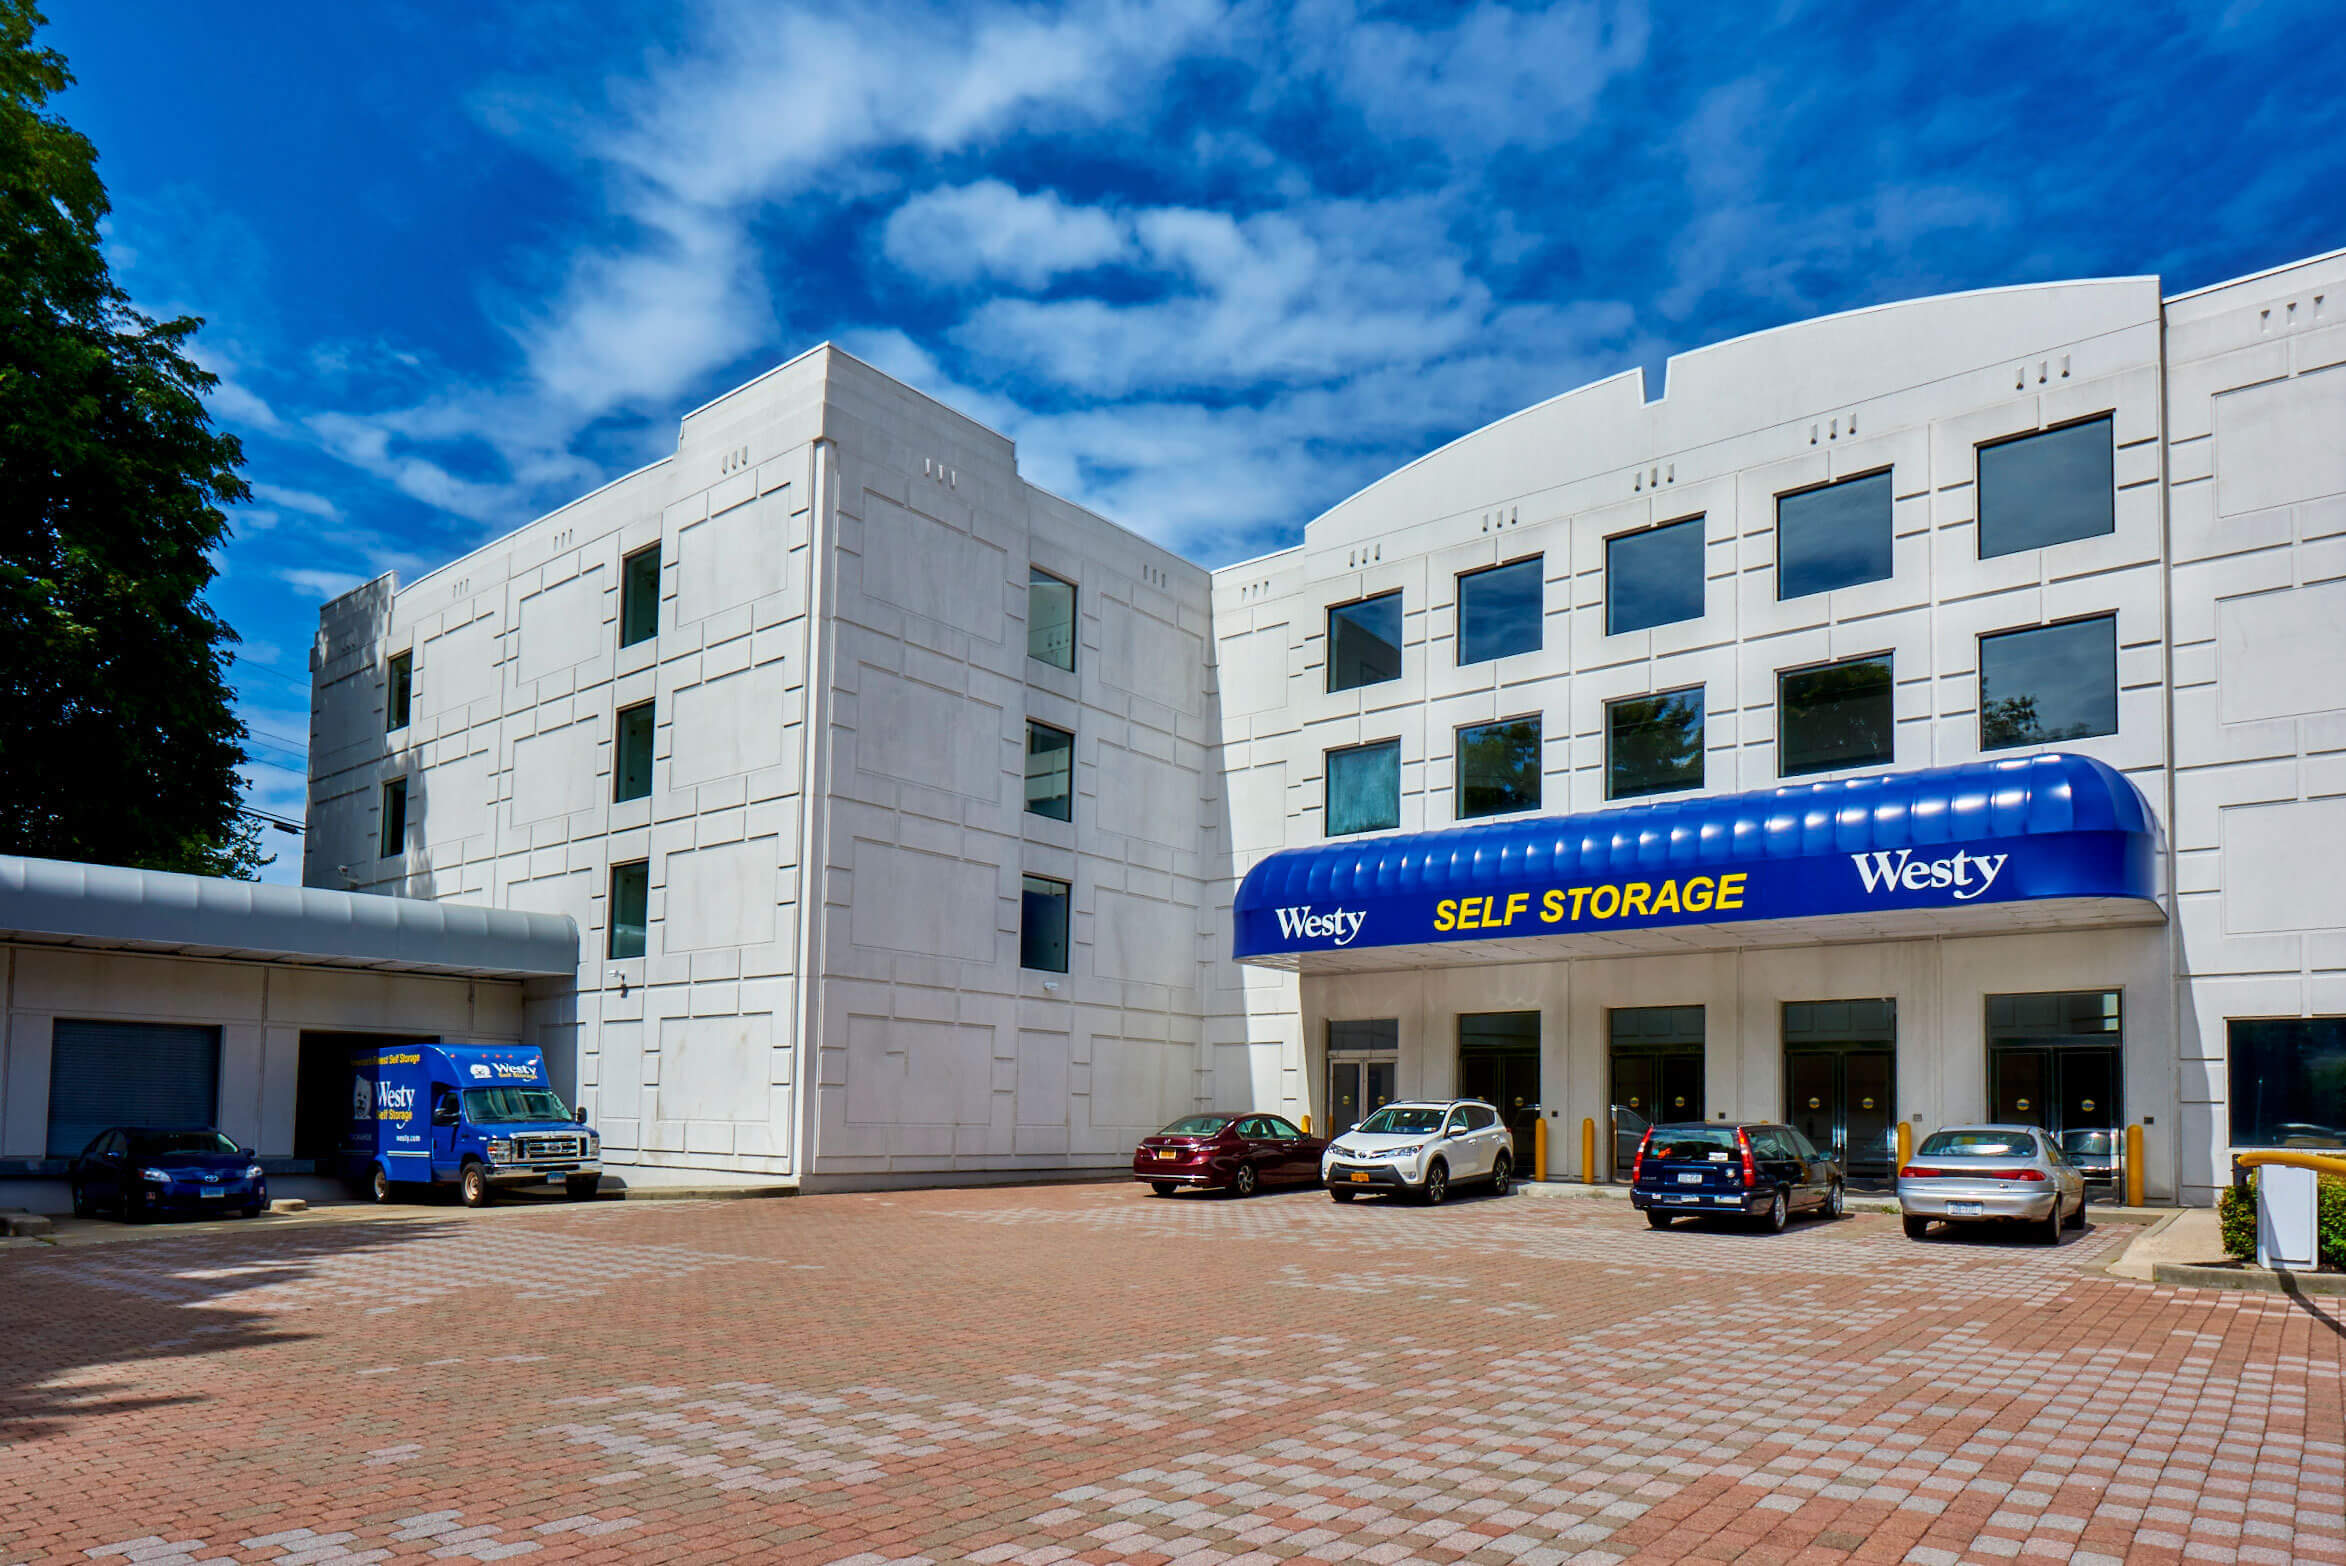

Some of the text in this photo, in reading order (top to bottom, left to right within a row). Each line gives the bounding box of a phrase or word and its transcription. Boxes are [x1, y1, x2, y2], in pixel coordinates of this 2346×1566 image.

[1850, 848, 2009, 900] Westy
[1433, 873, 1748, 932] SELF STORAGE
[1274, 906, 1367, 946] Westy
[491, 1062, 537, 1082] Westy
[375, 1080, 416, 1129] Westy
[389, 1108, 413, 1121] Storage
